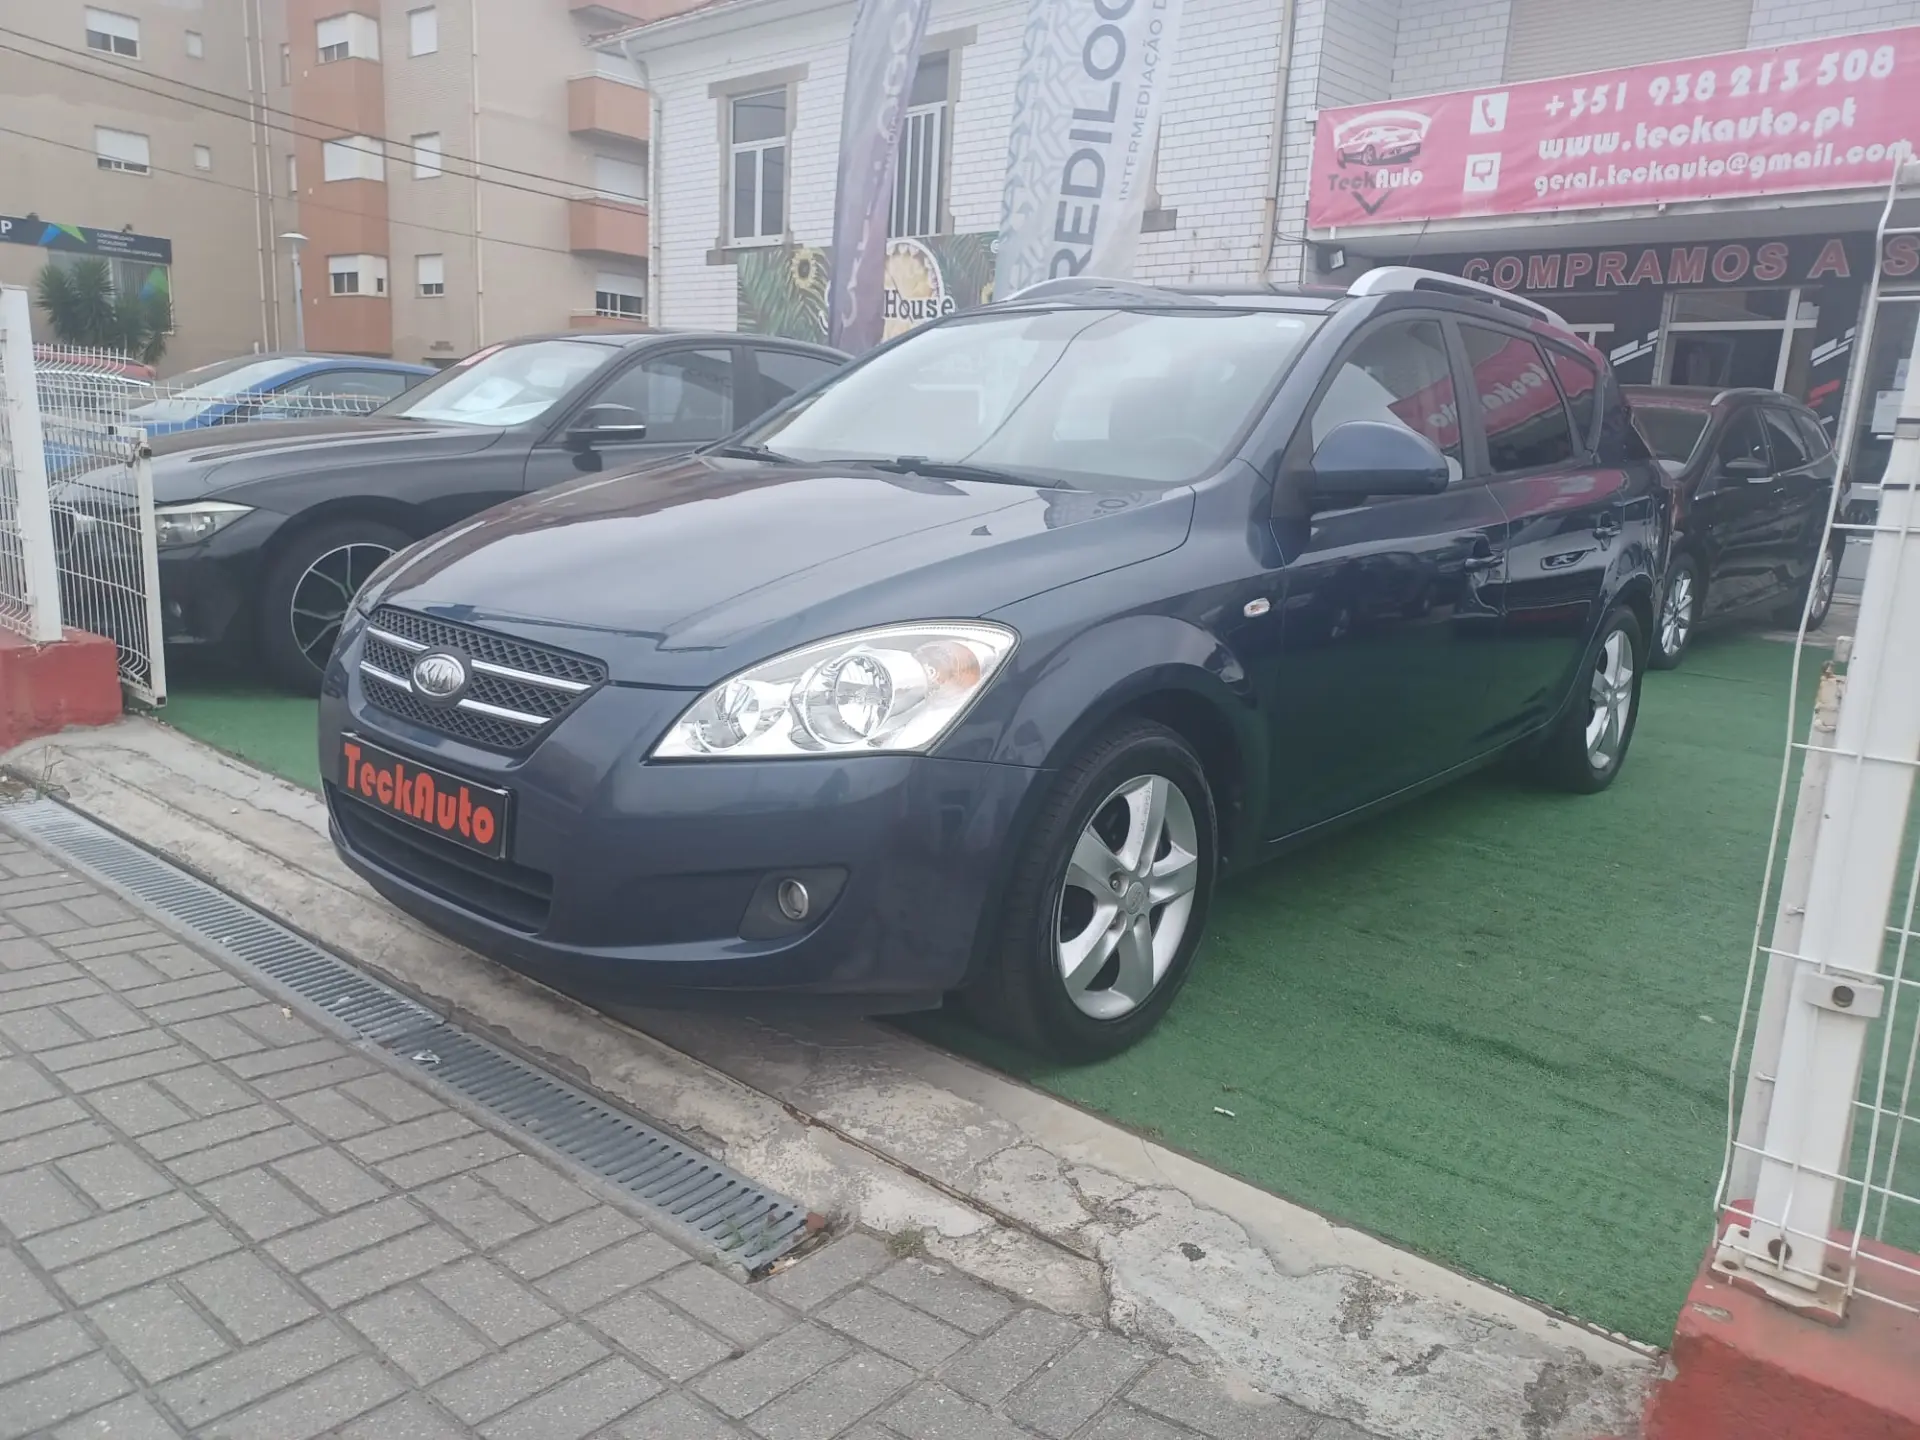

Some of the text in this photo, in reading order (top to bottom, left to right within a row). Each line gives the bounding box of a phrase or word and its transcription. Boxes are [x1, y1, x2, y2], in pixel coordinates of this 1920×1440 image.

[1119, 19, 1163, 200] INTERMEDIAÇÃO
[1545, 45, 1895, 118] +351 938 213 508
[1538, 96, 1857, 160] www.teckauto.pt
[1327, 168, 1424, 191] TeckAuto
[1462, 242, 1790, 291] COMPRAMOS
[1807, 239, 1851, 279] A
[884, 289, 955, 320] House
[344, 742, 495, 844] TeckAuto
